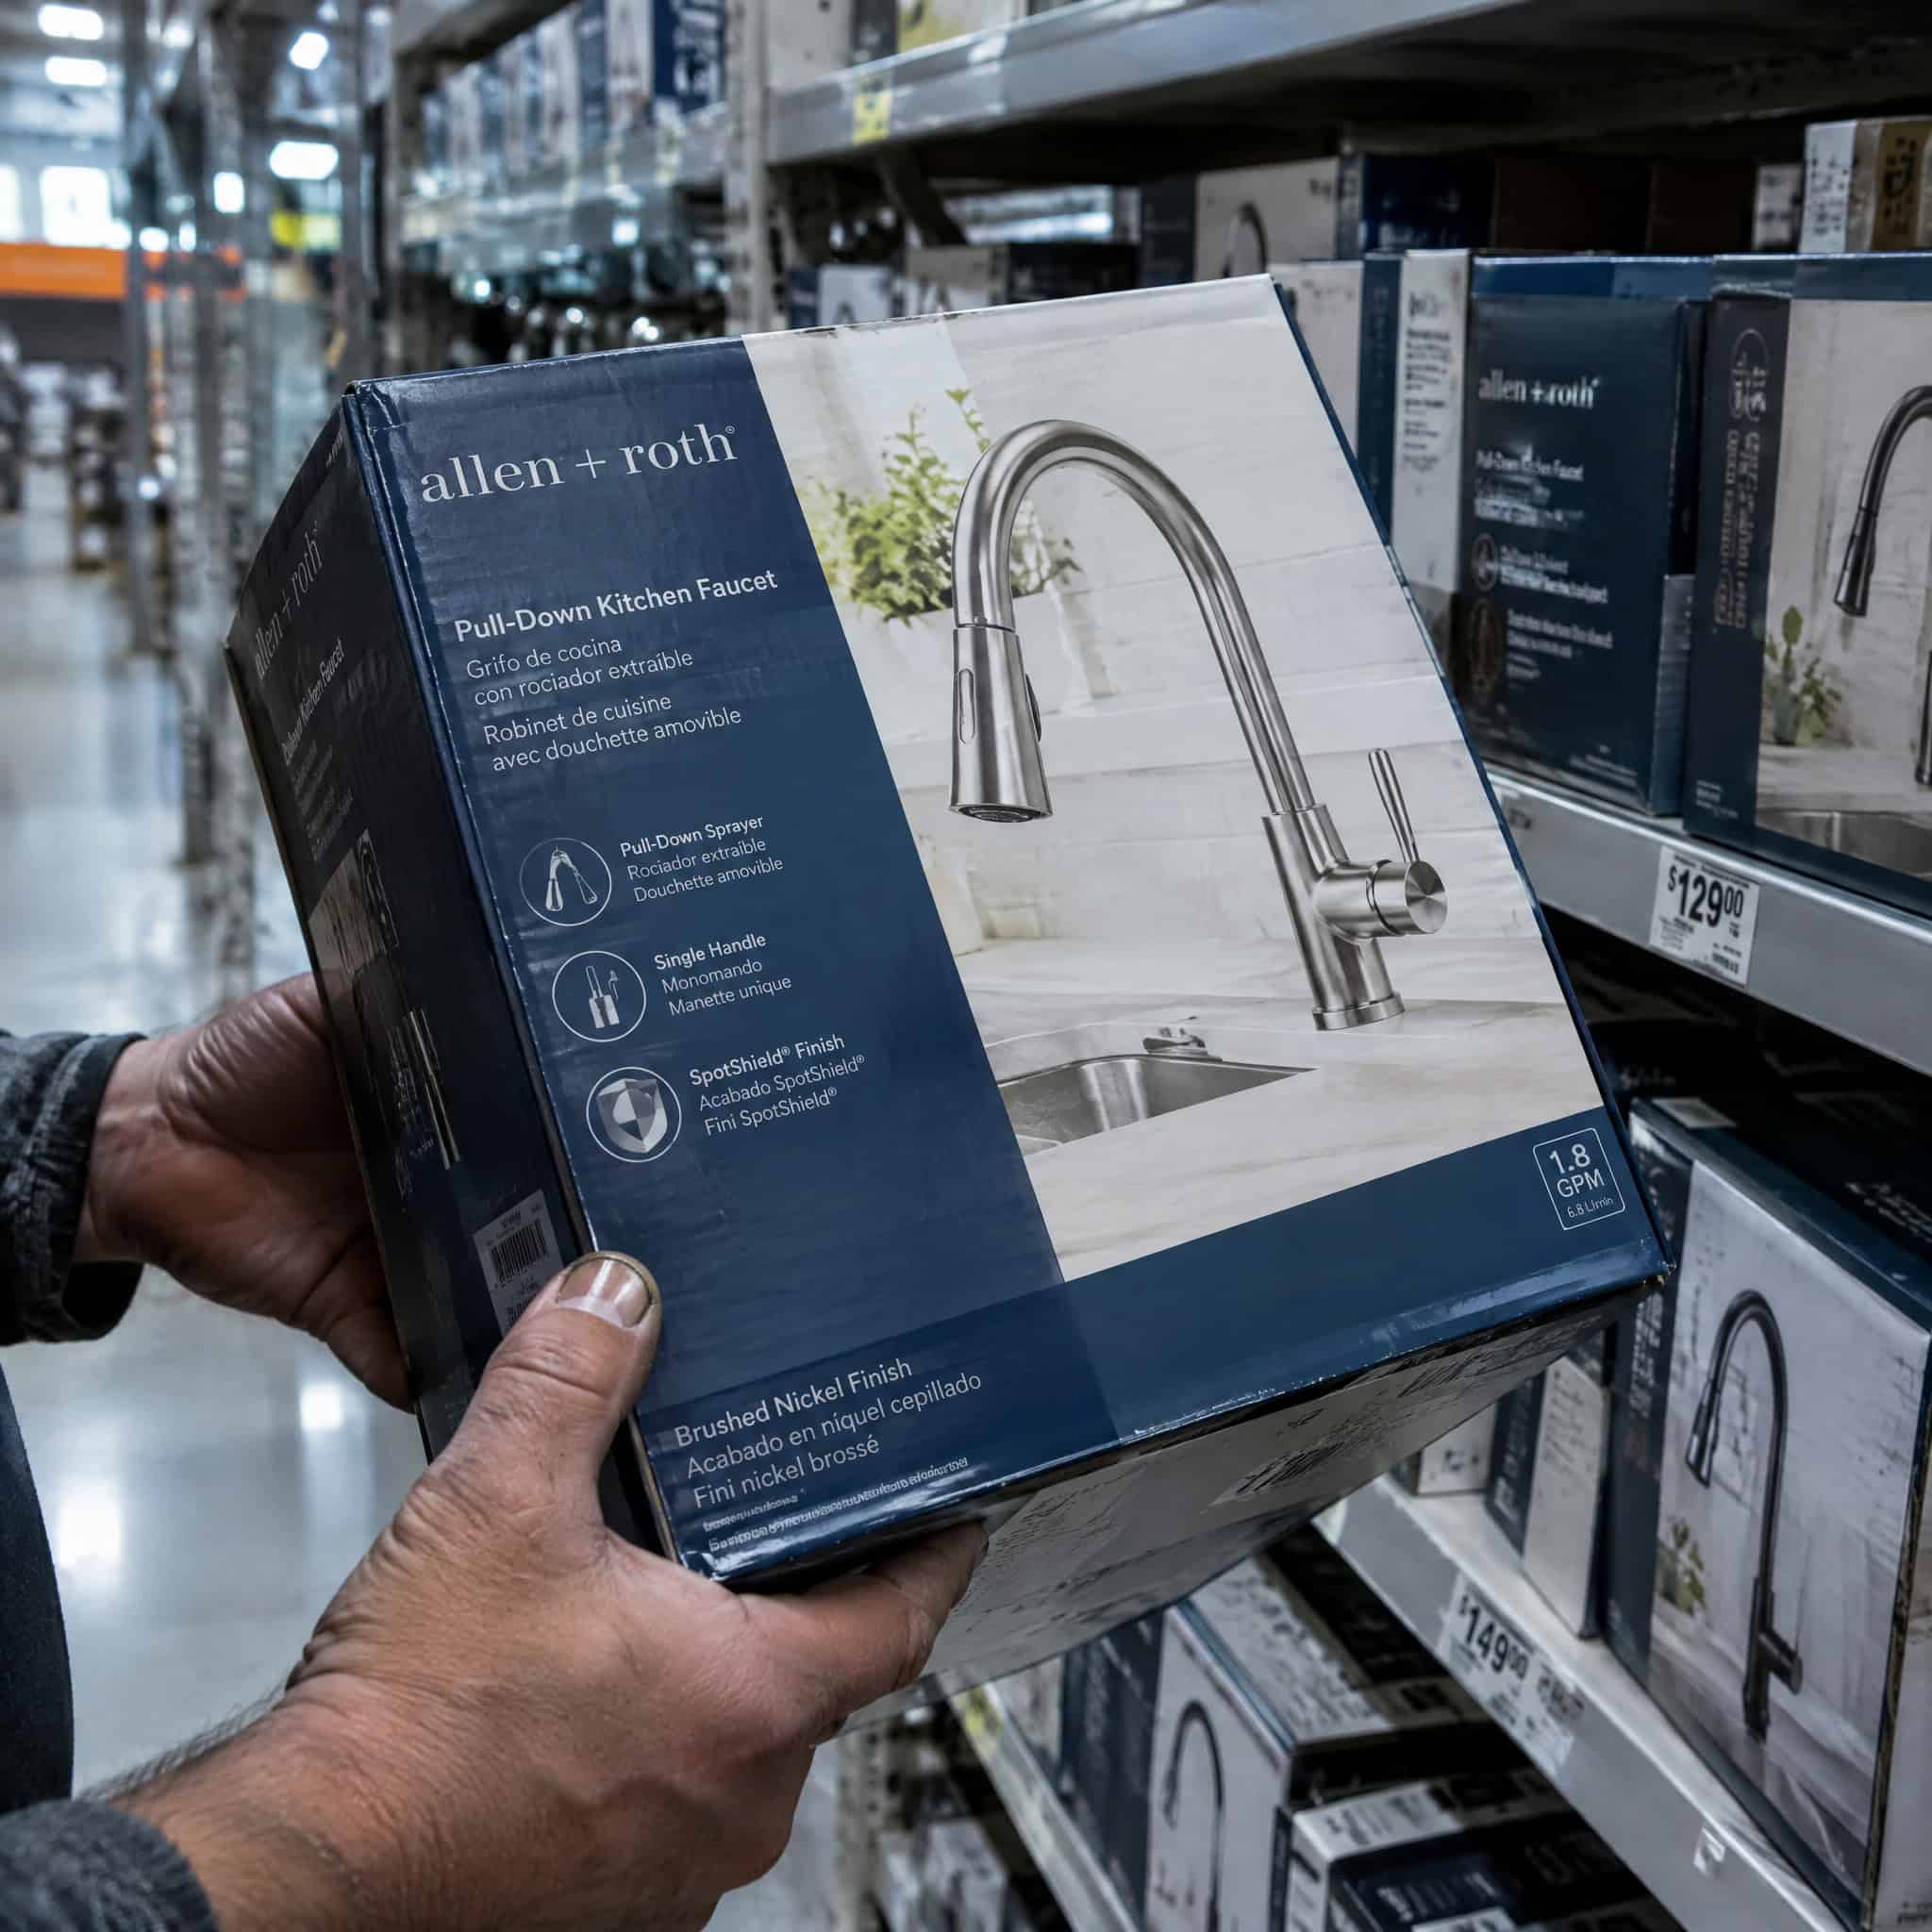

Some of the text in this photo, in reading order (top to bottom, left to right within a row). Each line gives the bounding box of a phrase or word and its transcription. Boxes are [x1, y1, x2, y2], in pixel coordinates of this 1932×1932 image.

[1478, 368, 1527, 403] allen
[420, 454, 565, 503] allen
[575, 449, 607, 478] +
[455, 570, 778, 642] Pull-Down Kitchen Faucet
[466, 637, 623, 680] Grifo de cocina
[475, 650, 693, 706] con rociador extraíble
[483, 694, 672, 745] Robinet de cuisine
[492, 708, 741, 772] avec douchette amovible
[620, 816, 764, 858] Pull-Down Sprayer
[626, 853, 697, 880] Rociador
[633, 857, 784, 903] Douchette amovible
[655, 934, 767, 974] Single Handle
[661, 958, 763, 993] Monomando
[668, 974, 792, 1016] Manette unique
[794, 1034, 845, 1058] Finish
[698, 1078, 771, 1111] Acabado
[705, 1113, 737, 1136] Fini
[1549, 1143, 1591, 1174] 1.8
[1557, 1168, 1605, 1197] GPM
[1567, 1204, 1585, 1218] 6.8
[675, 1357, 913, 1448] Brushed Nickel Finish
[687, 1372, 982, 1479] Acabado en níquel cepillado
[692, 1478, 737, 1509] Fini
[741, 1456, 806, 1496] nickel
[808, 1434, 880, 1473] brossé
